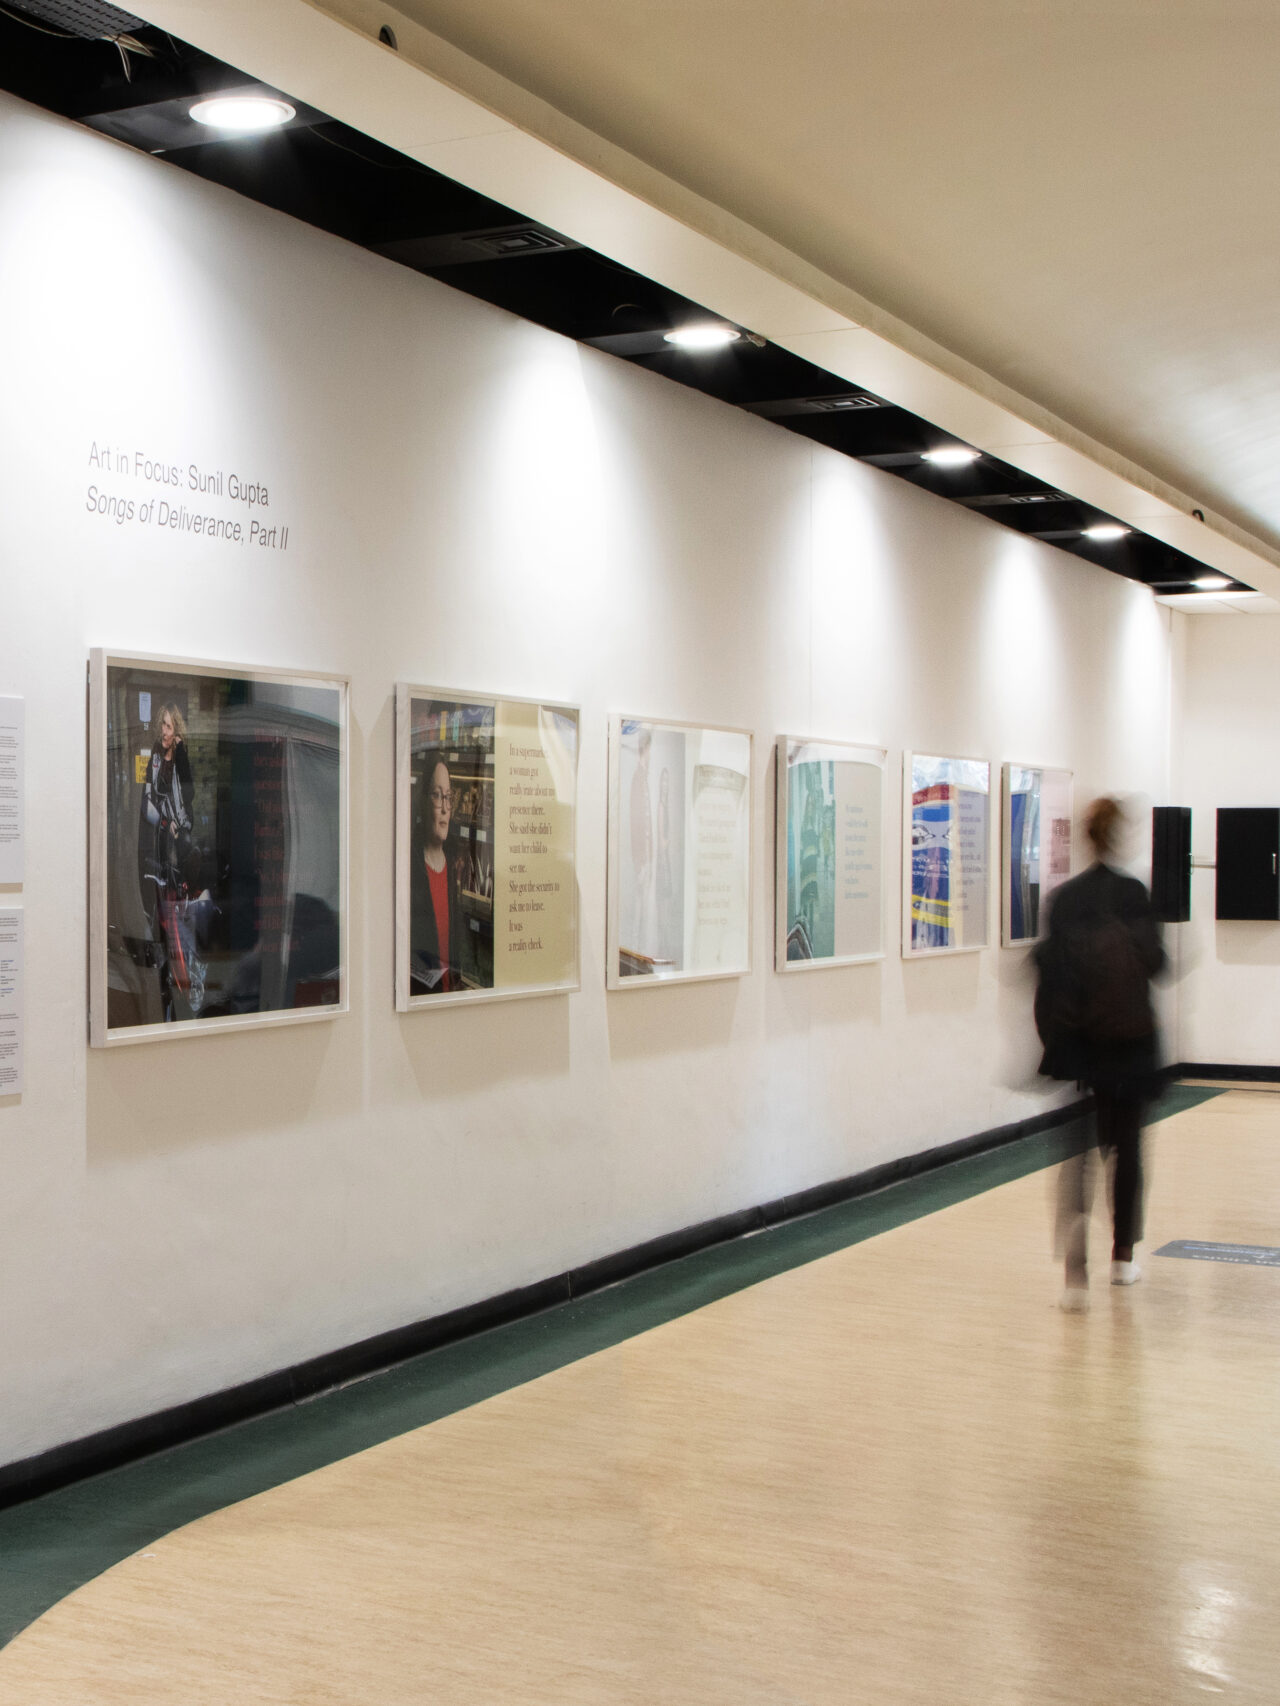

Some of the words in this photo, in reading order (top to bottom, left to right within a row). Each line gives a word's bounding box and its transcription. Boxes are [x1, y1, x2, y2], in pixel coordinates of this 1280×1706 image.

[88, 441, 111, 471] Art
[116, 447, 129, 475] in
[135, 452, 183, 487] Focus:
[188, 464, 223, 496] Sunil
[228, 474, 269, 509] Gupta
[86, 485, 134, 525] Songs
[139, 499, 155, 524] of
[158, 501, 245, 545] Deliverance,
[250, 520, 276, 549] Part
[280, 527, 289, 550] II
